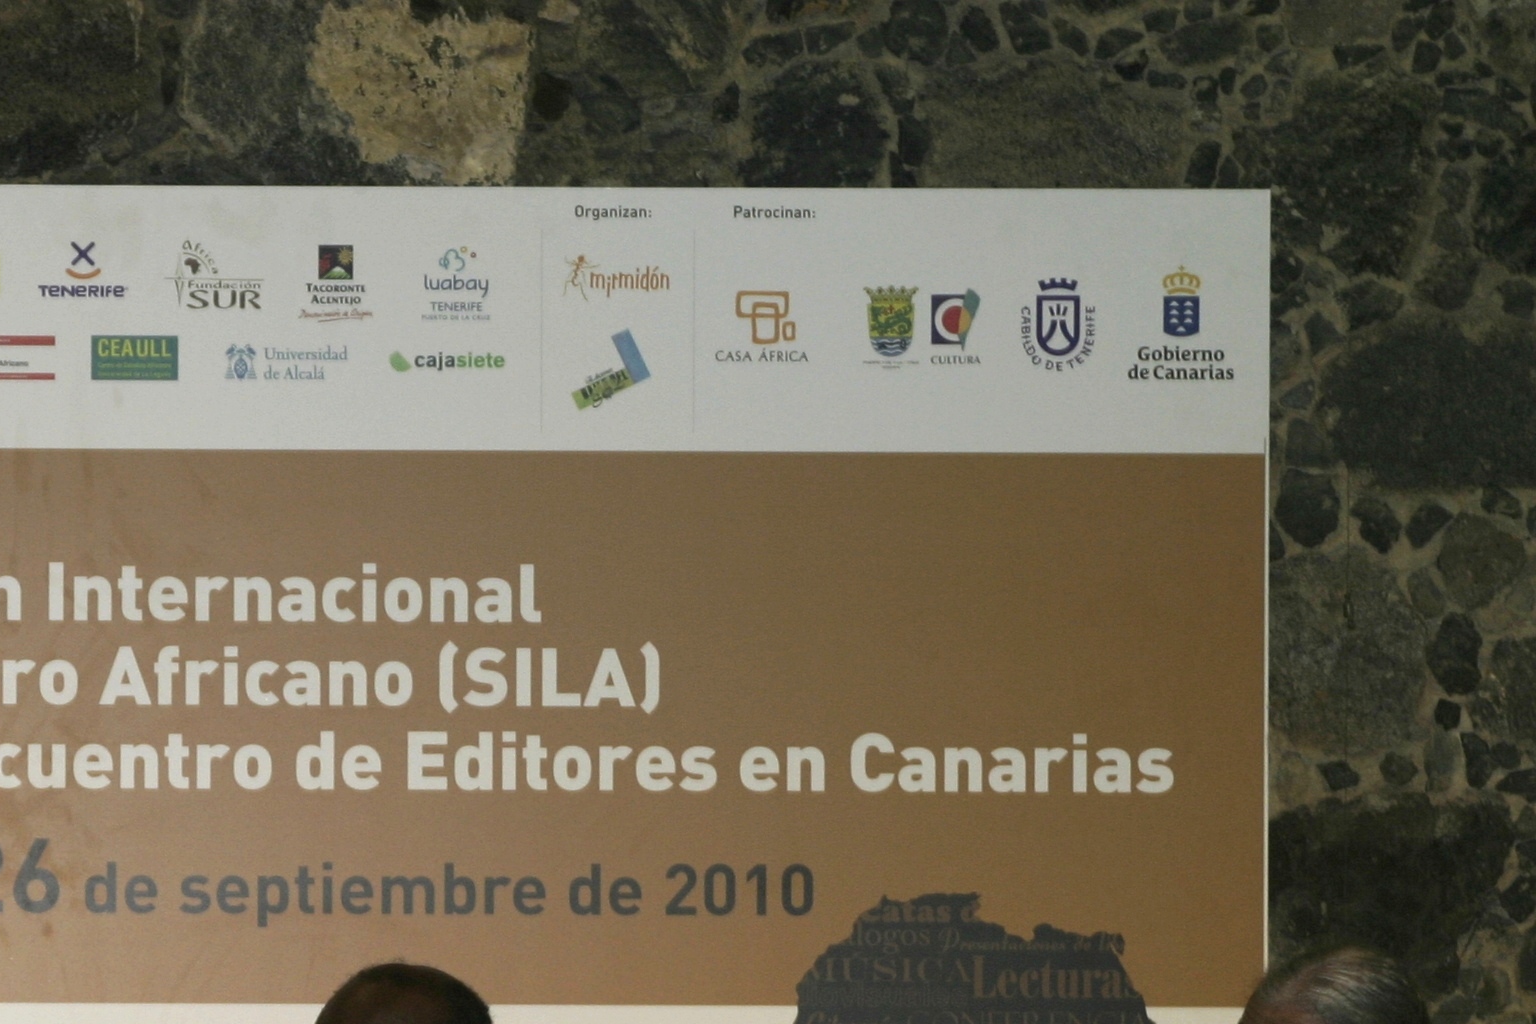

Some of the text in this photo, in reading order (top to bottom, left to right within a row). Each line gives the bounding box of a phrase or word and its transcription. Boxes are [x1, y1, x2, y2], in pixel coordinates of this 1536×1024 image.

[574, 205, 652, 220] Organizan:
[733, 205, 816, 219] Patrocinan:
[187, 280, 261, 290] Fundación
[306, 283, 366, 293] TACORONTE
[423, 274, 489, 298] luabay
[187, 291, 262, 310] SUR
[310, 294, 362, 304] ACENTEJO
[430, 301, 483, 312] TENERIFE
[1020, 306, 1096, 372] CABILDO DE TENERIFE
[264, 346, 348, 361] Universidad
[715, 347, 809, 362] CASA ÁFRICA
[930, 355, 981, 364] CULTURA
[1137, 345, 1225, 361] Gobierno
[414, 352, 506, 372] cajasiete
[264, 365, 325, 380] de Alcalá
[1128, 364, 1234, 381] de Canarias
[47, 561, 542, 624] Internacional
[99, 645, 414, 707] Africano
[438, 640, 661, 714] (SILA)
[294, 730, 382, 791] de
[407, 730, 718, 792] Editores
[739, 744, 826, 793] en
[849, 732, 1175, 794] Canarias
[83, 861, 158, 915] de
[179, 861, 546, 928] septiembre
[568, 863, 643, 917] de
[664, 863, 816, 917] 2010
